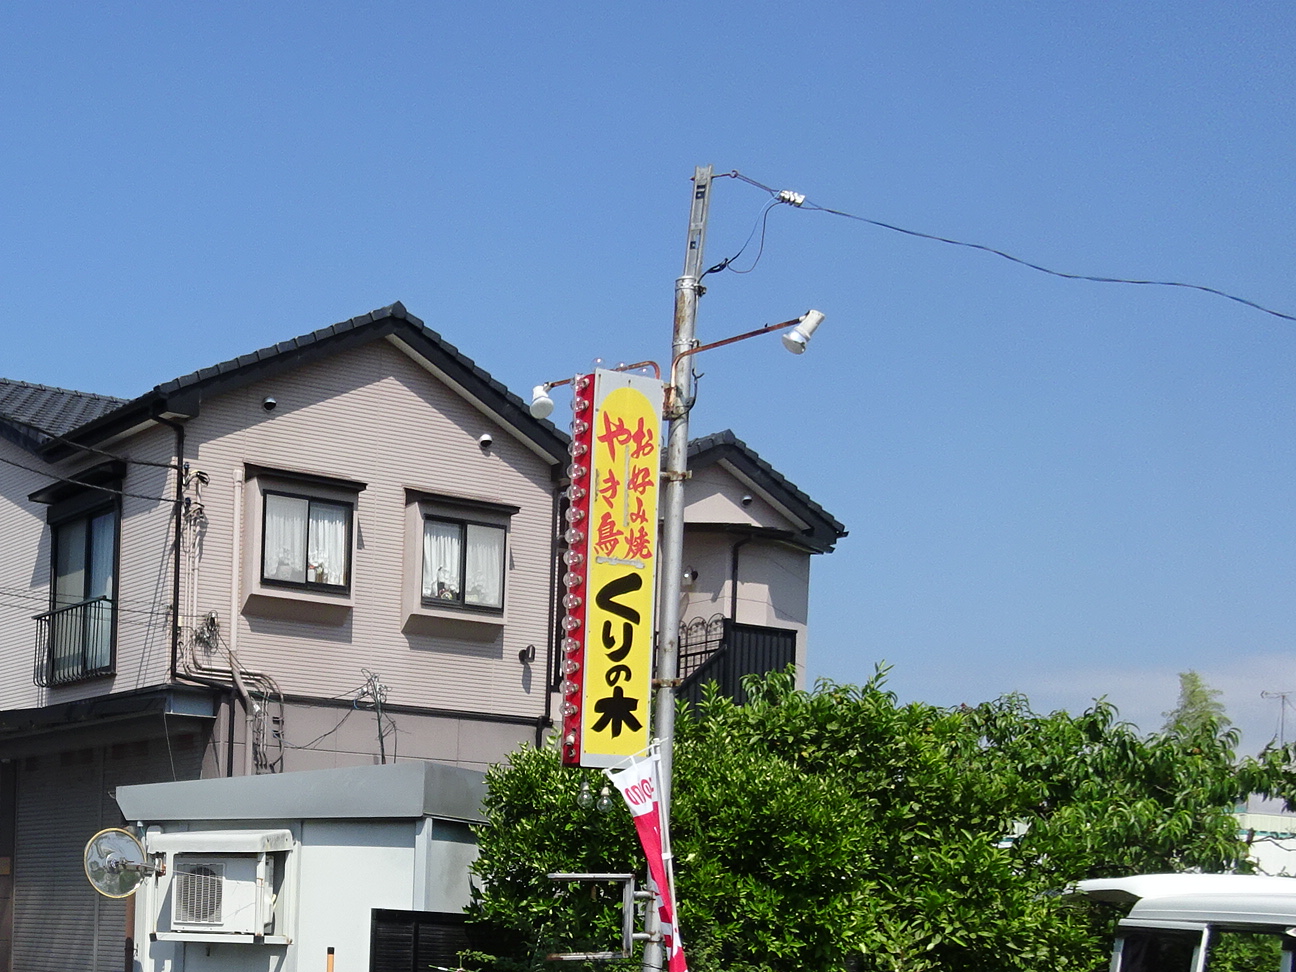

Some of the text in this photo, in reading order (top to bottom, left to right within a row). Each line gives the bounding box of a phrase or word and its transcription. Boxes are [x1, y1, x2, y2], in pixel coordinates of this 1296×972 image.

[593, 409, 633, 556] やき鳥
[623, 416, 655, 560] お好み焼
[590, 572, 644, 739] くりの木
